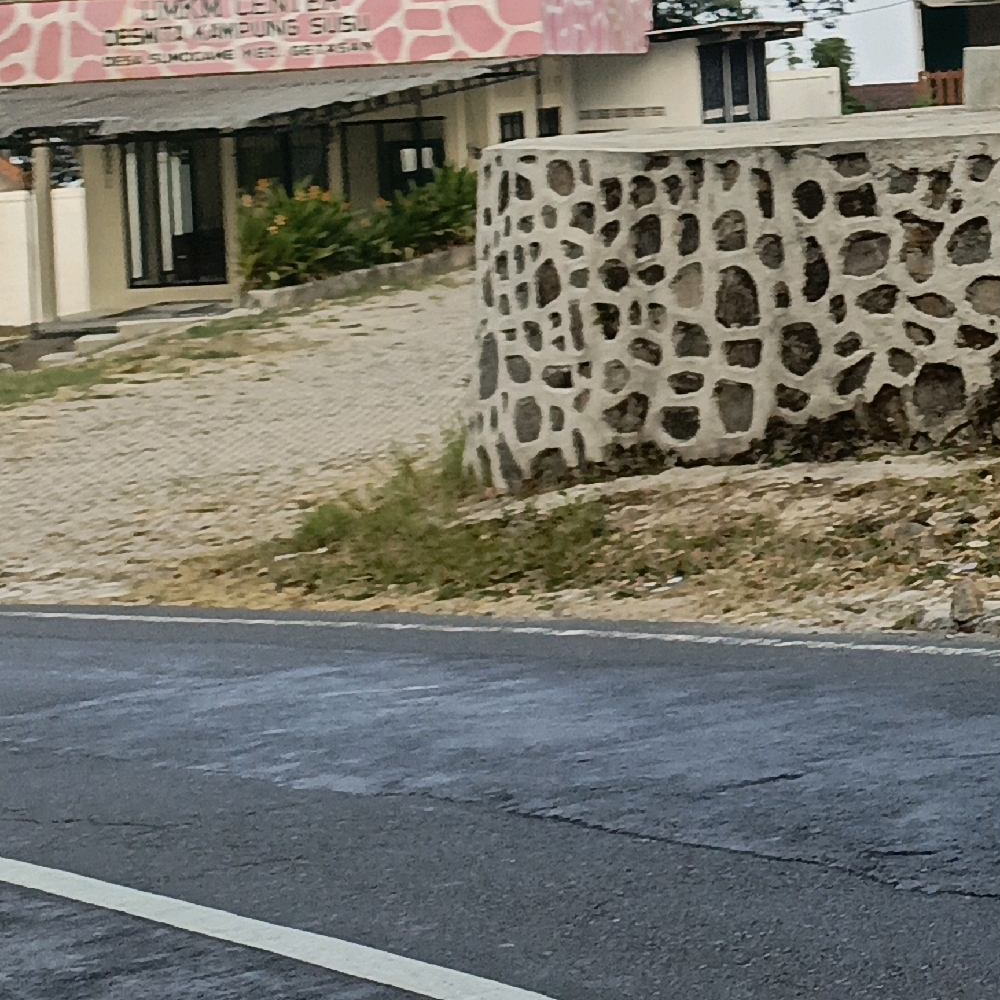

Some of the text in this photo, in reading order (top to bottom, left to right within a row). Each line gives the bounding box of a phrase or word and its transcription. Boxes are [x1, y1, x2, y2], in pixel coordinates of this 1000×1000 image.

[195, 18, 300, 41] KAMPUNG
[309, 13, 371, 35] SUSU
[102, 54, 143, 67] DESA
